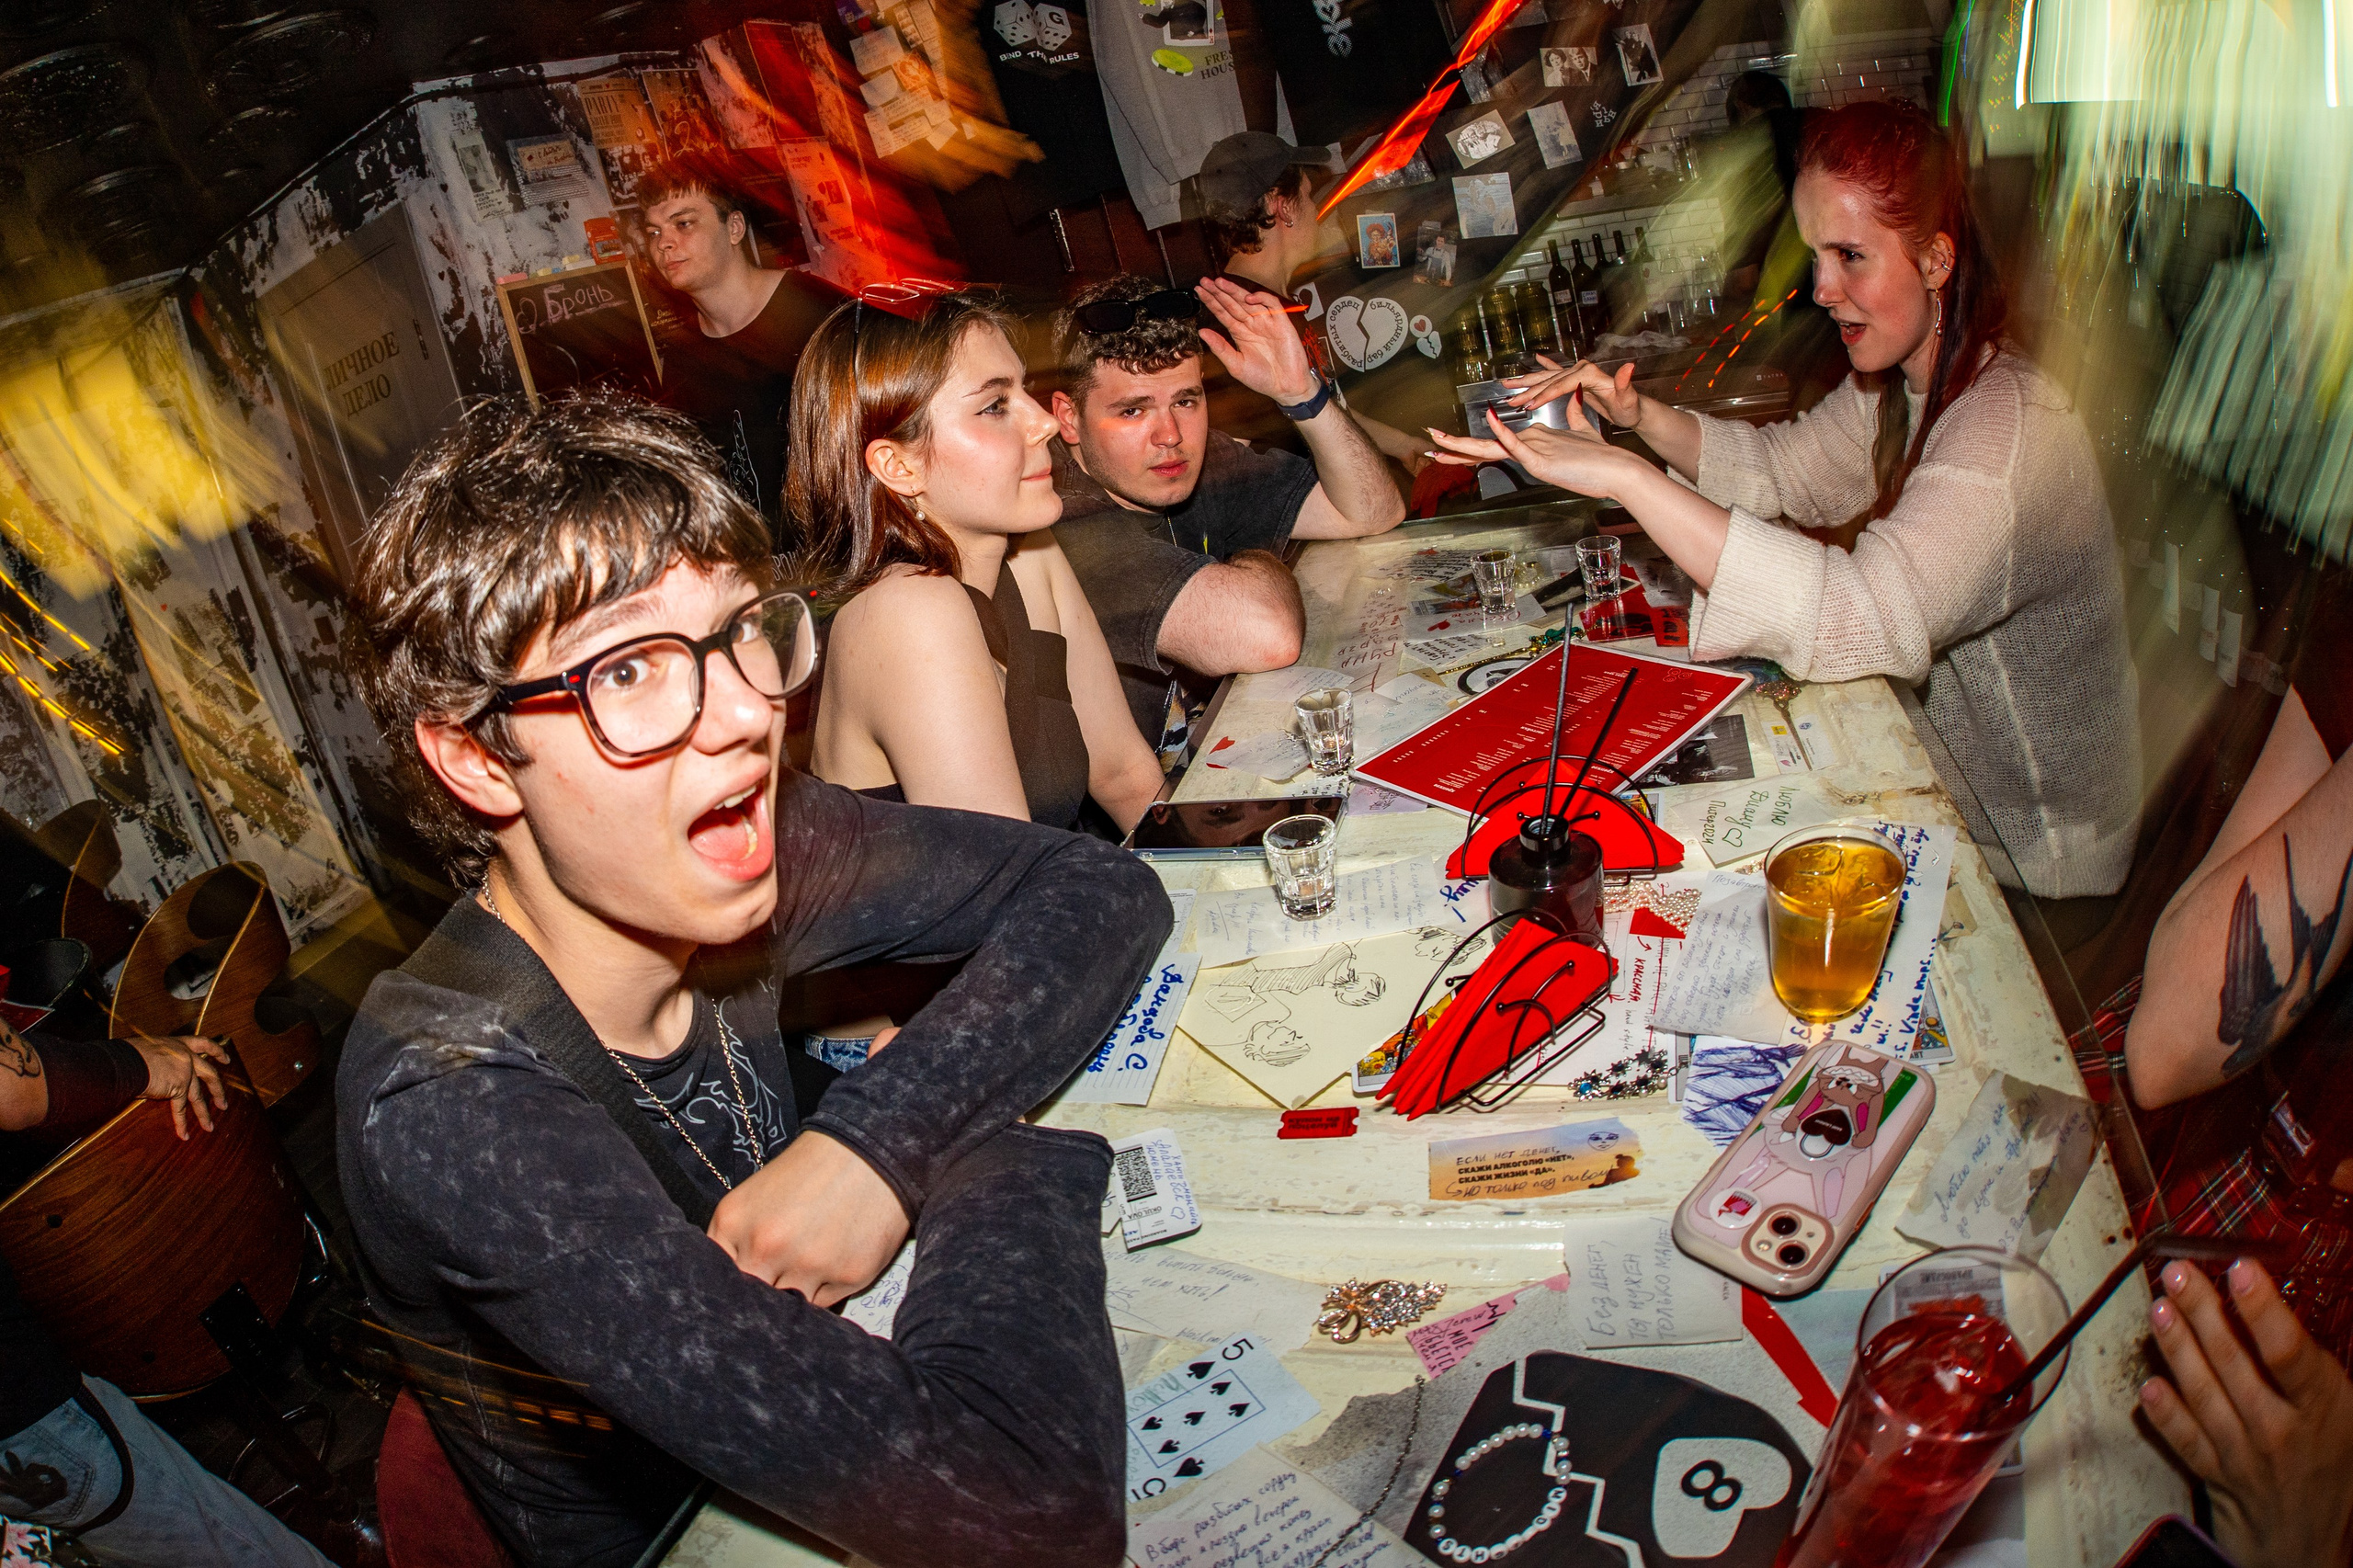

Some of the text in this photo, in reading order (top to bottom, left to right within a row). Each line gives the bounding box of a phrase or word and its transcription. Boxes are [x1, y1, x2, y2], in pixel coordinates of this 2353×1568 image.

[1049, 11, 1064, 26] G
[1049, 51, 1080, 64] RULES
[1200, 61, 1235, 80] HOUS
[585, 95, 620, 116] PARTY
[1329, 299, 1363, 369] разбитых сердец
[1367, 301, 1404, 364] бильярдный бар
[326, 331, 401, 392] ЛИЧНОЕ
[342, 373, 392, 419] ДЕЛО
[1725, 790, 1769, 829] Диану
[1770, 786, 1800, 825] Люблю
[1909, 1051, 1924, 1060] АНТ
[1456, 1153, 1486, 1165] ЕСЛИ
[1494, 1151, 1514, 1160] НЕТ
[1458, 1163, 1492, 1175] СКАЖИ
[1494, 1158, 1543, 1170] АЛКОГОЛЮ
[1459, 1173, 1492, 1184] СКАЖИ
[1494, 1168, 1529, 1180] ЖИЗНИ
[1142, 1276, 1173, 1288] чем
[1222, 1338, 1254, 1360] 5
[1680, 1460, 1744, 1513] 8
